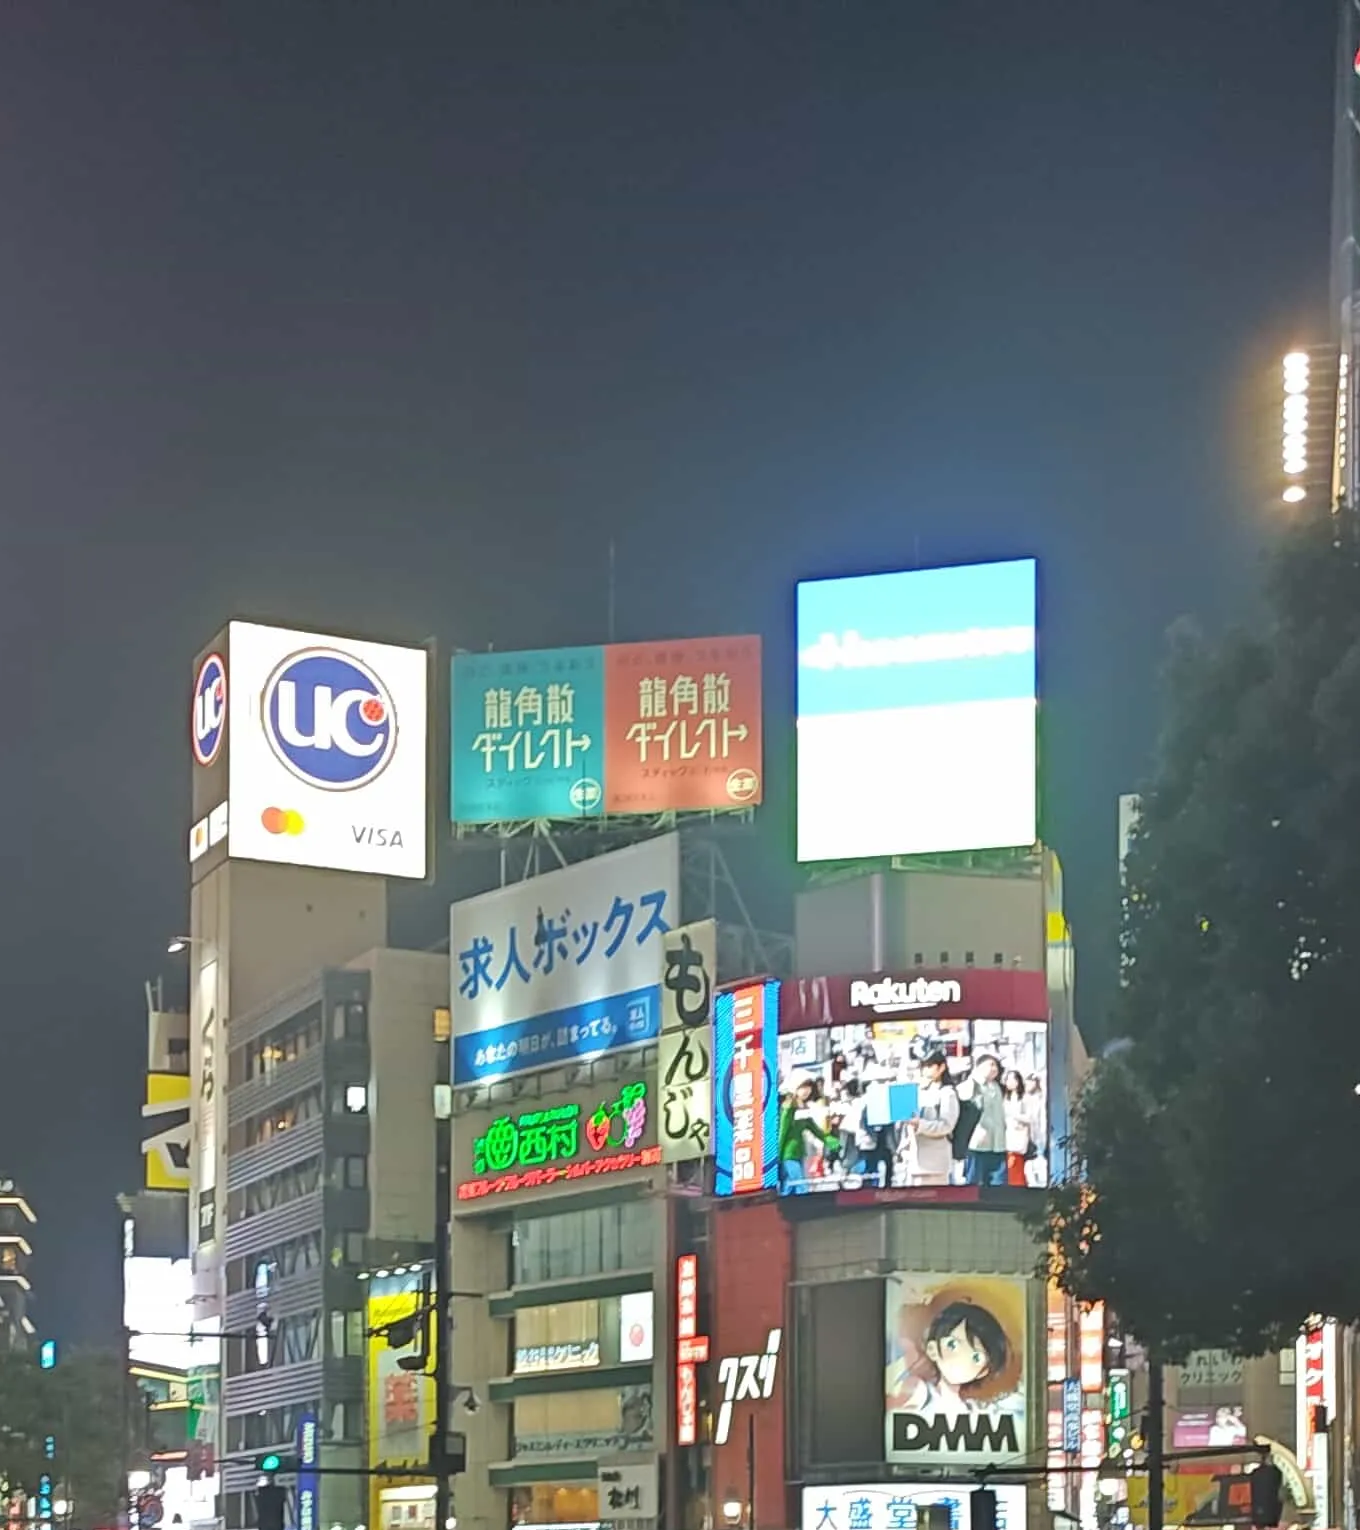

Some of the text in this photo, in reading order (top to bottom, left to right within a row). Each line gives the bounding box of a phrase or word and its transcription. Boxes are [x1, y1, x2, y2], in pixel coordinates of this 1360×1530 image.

[483, 681, 575, 729] 龍角散
[638, 671, 731, 719] 龍角散
[352, 824, 404, 849] VISA
[458, 889, 671, 1001] 求人ボックス
[850, 977, 961, 1010] Rakuten
[664, 932, 711, 1151] もんじゃ
[892, 1412, 1020, 1453] DMM
